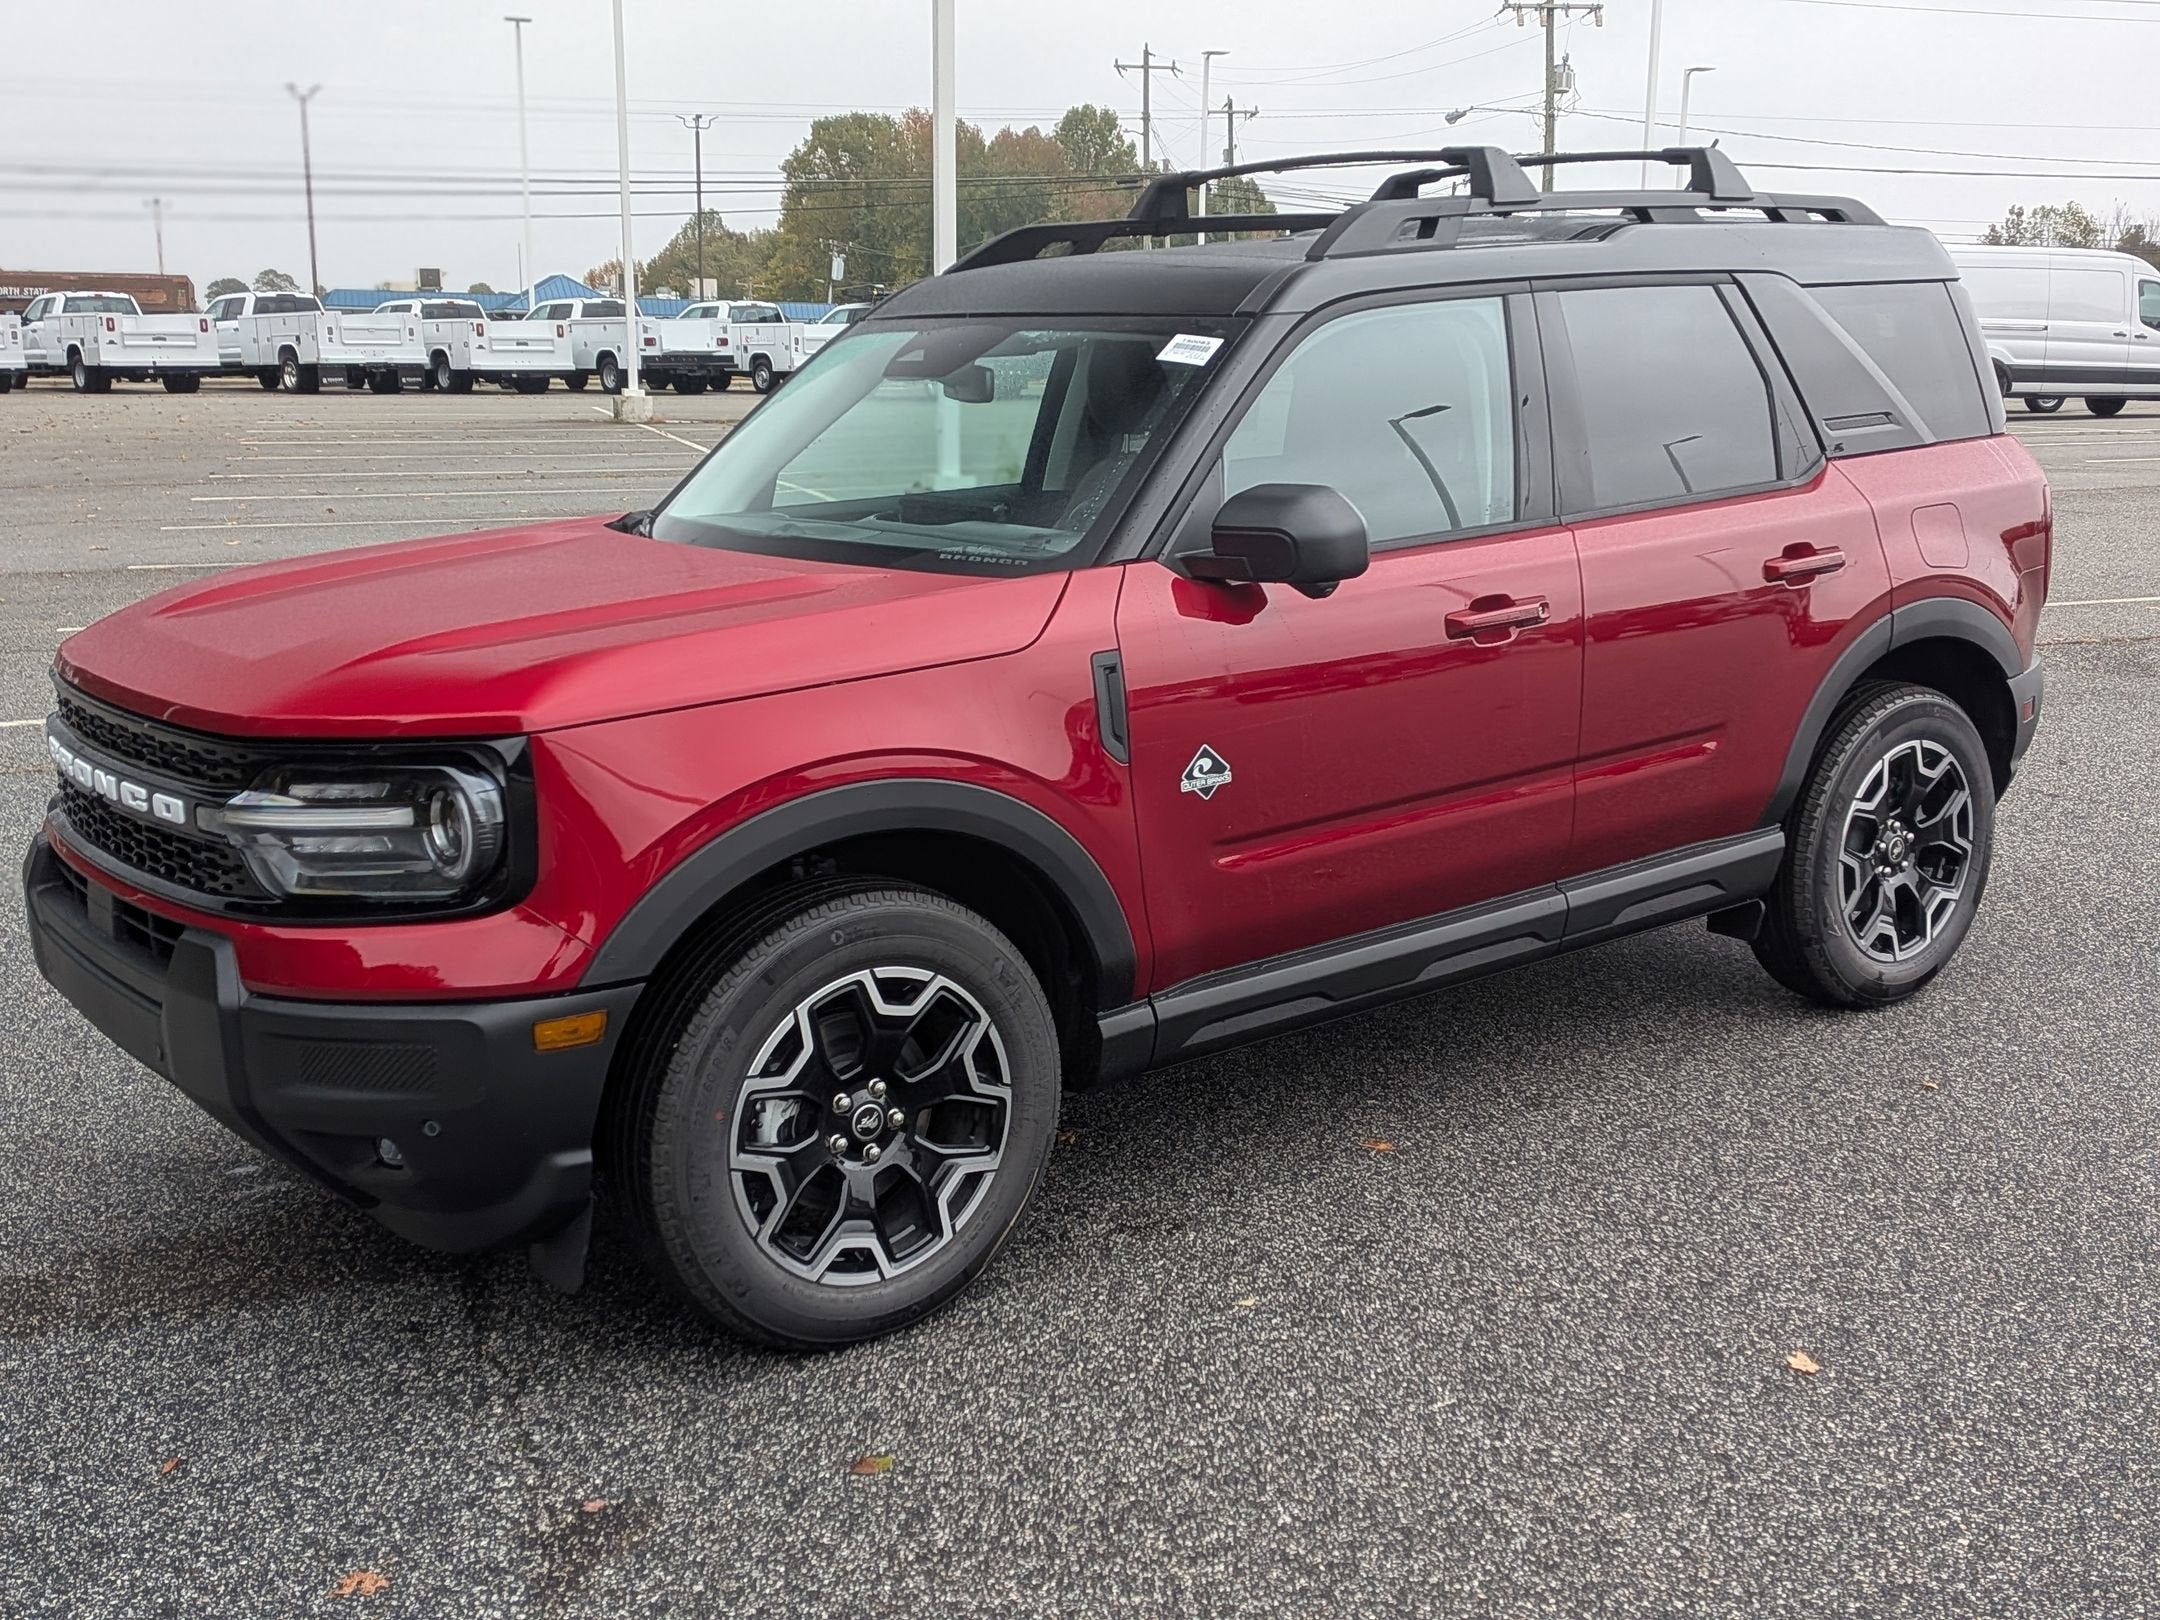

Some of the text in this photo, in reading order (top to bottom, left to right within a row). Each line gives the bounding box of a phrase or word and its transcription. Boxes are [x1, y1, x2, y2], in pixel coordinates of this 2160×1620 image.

[23, 287, 49, 296] STATE
[939, 554, 1028, 565] BRONCO
[48, 735, 187, 825] BRONCO
[1184, 773, 1229, 790] OUTER BANKS
